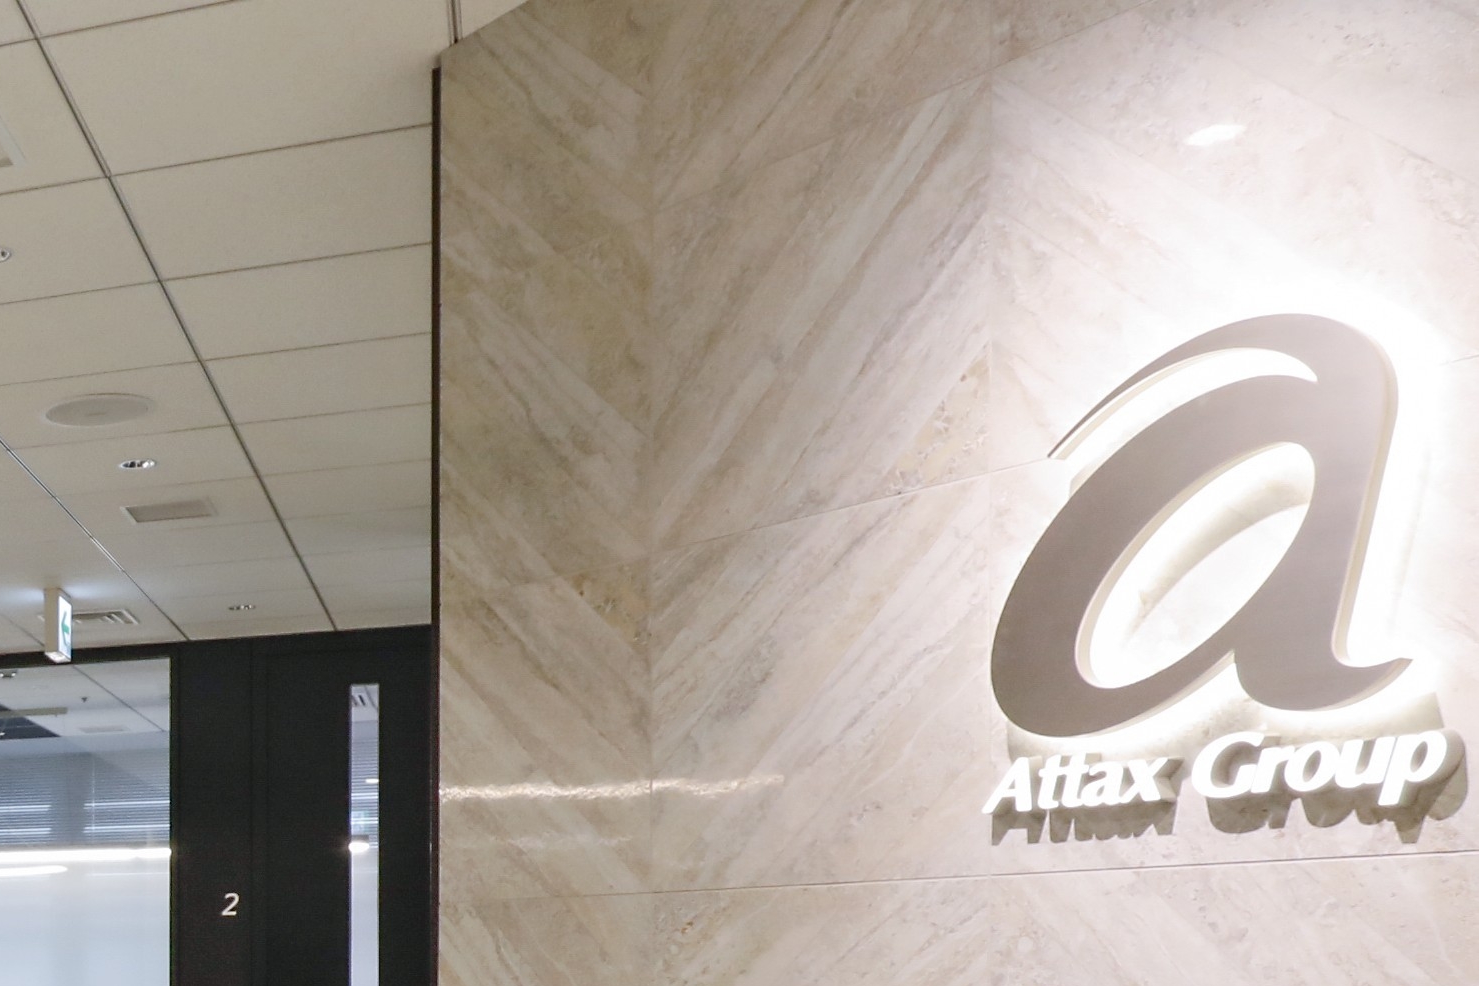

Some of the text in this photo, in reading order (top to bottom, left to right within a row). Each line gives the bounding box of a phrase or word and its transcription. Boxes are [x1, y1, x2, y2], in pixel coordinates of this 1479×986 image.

[981, 730, 1448, 815] Attax Group
[221, 892, 240, 917] 2
